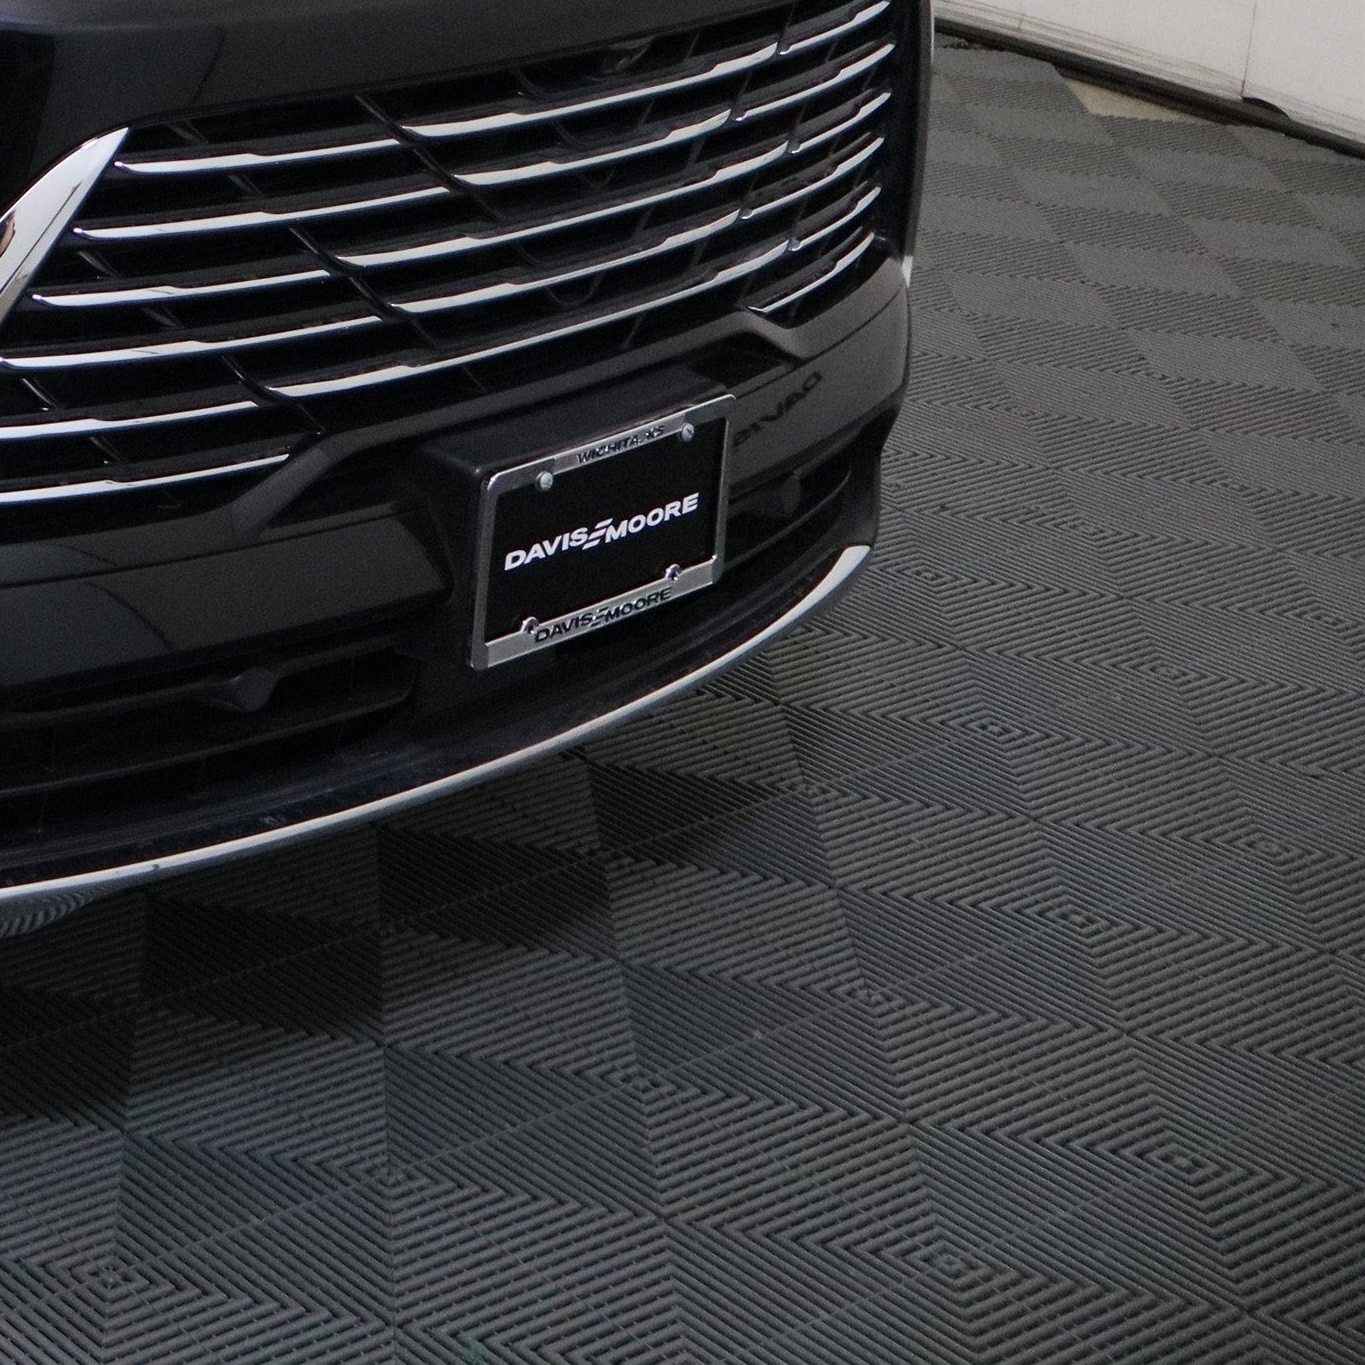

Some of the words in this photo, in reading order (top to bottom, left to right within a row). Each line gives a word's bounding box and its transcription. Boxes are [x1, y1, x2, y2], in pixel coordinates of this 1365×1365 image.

[504, 527, 594, 571] DAVIS
[605, 492, 700, 545] MOORE
[534, 612, 594, 643] DAVIS
[604, 586, 672, 622] MOORE
